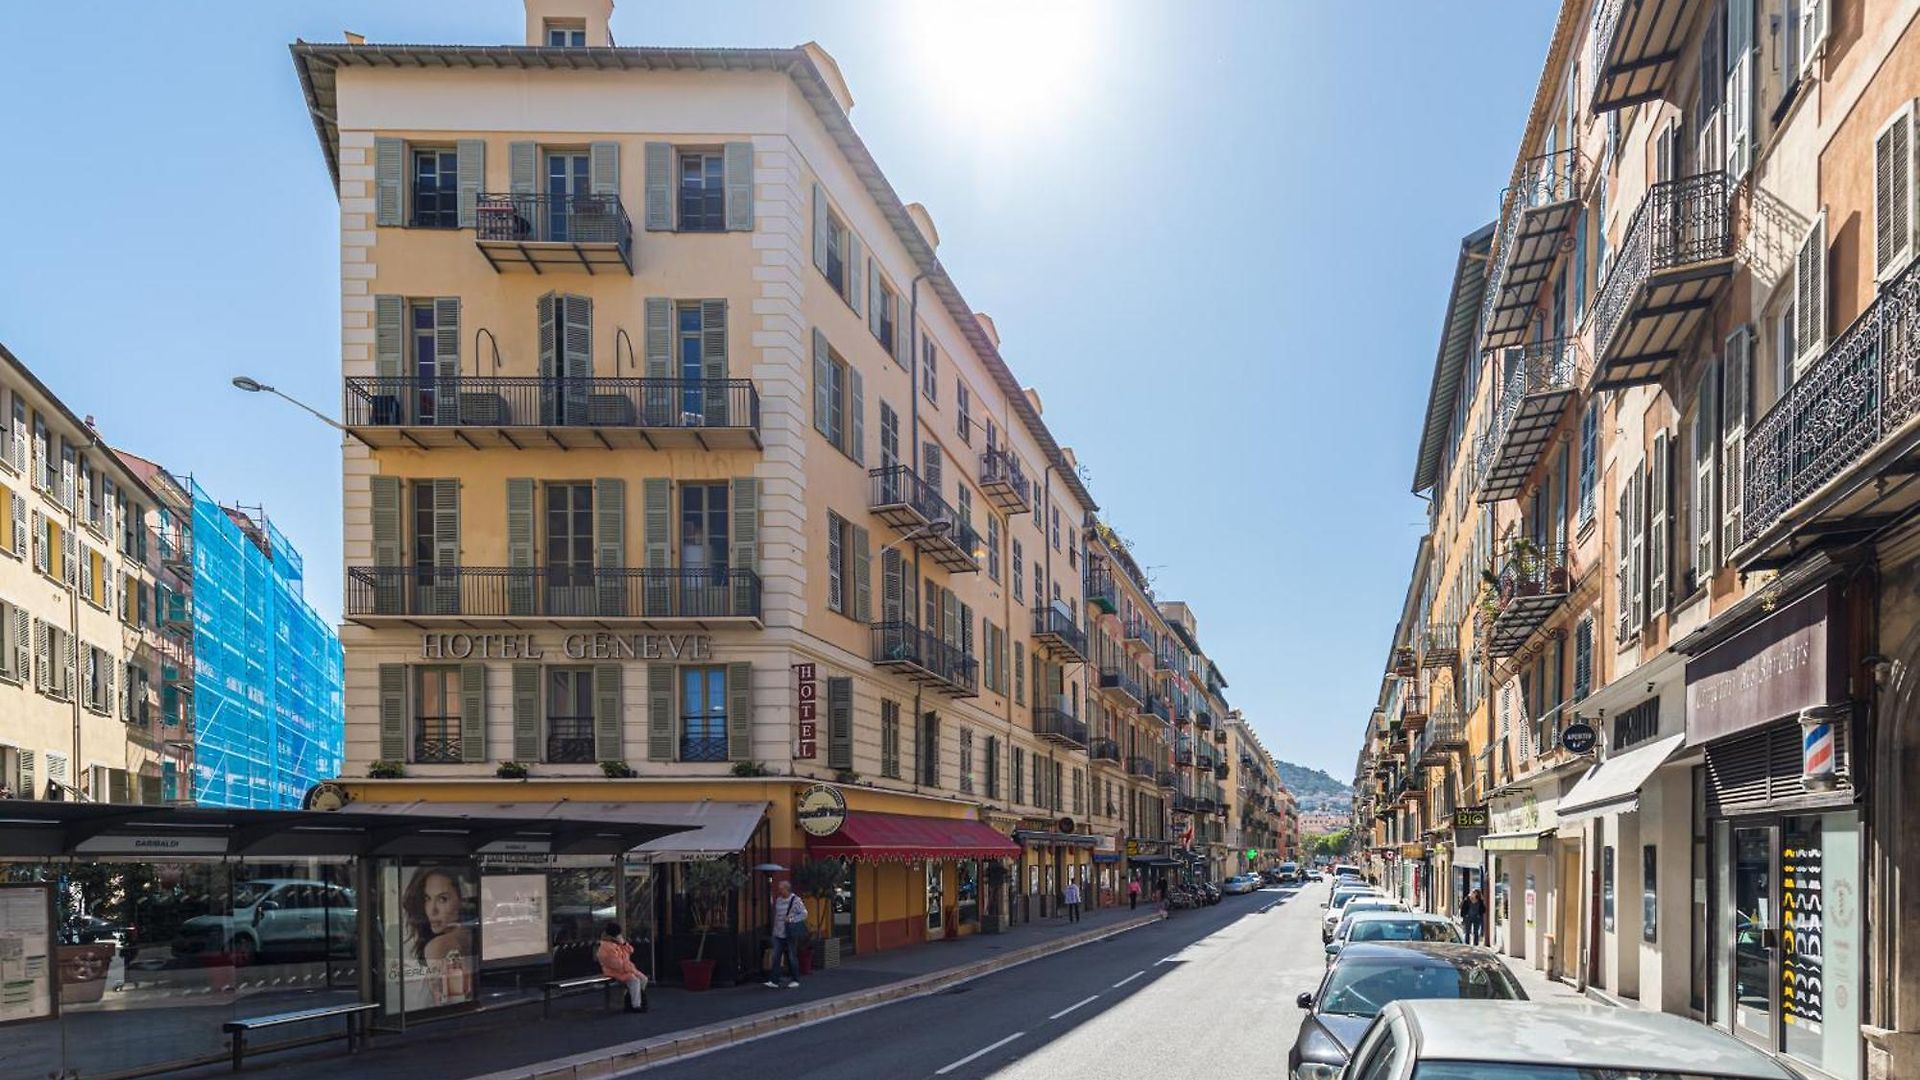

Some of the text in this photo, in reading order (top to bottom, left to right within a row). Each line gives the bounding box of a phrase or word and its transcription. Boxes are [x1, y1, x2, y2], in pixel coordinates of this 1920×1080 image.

[421, 632, 713, 660] HOTEL GENEVE
[801, 666, 811, 757] HOTEL
[1458, 813, 1484, 825] BIO
[135, 840, 179, 848] GARIBALDI
